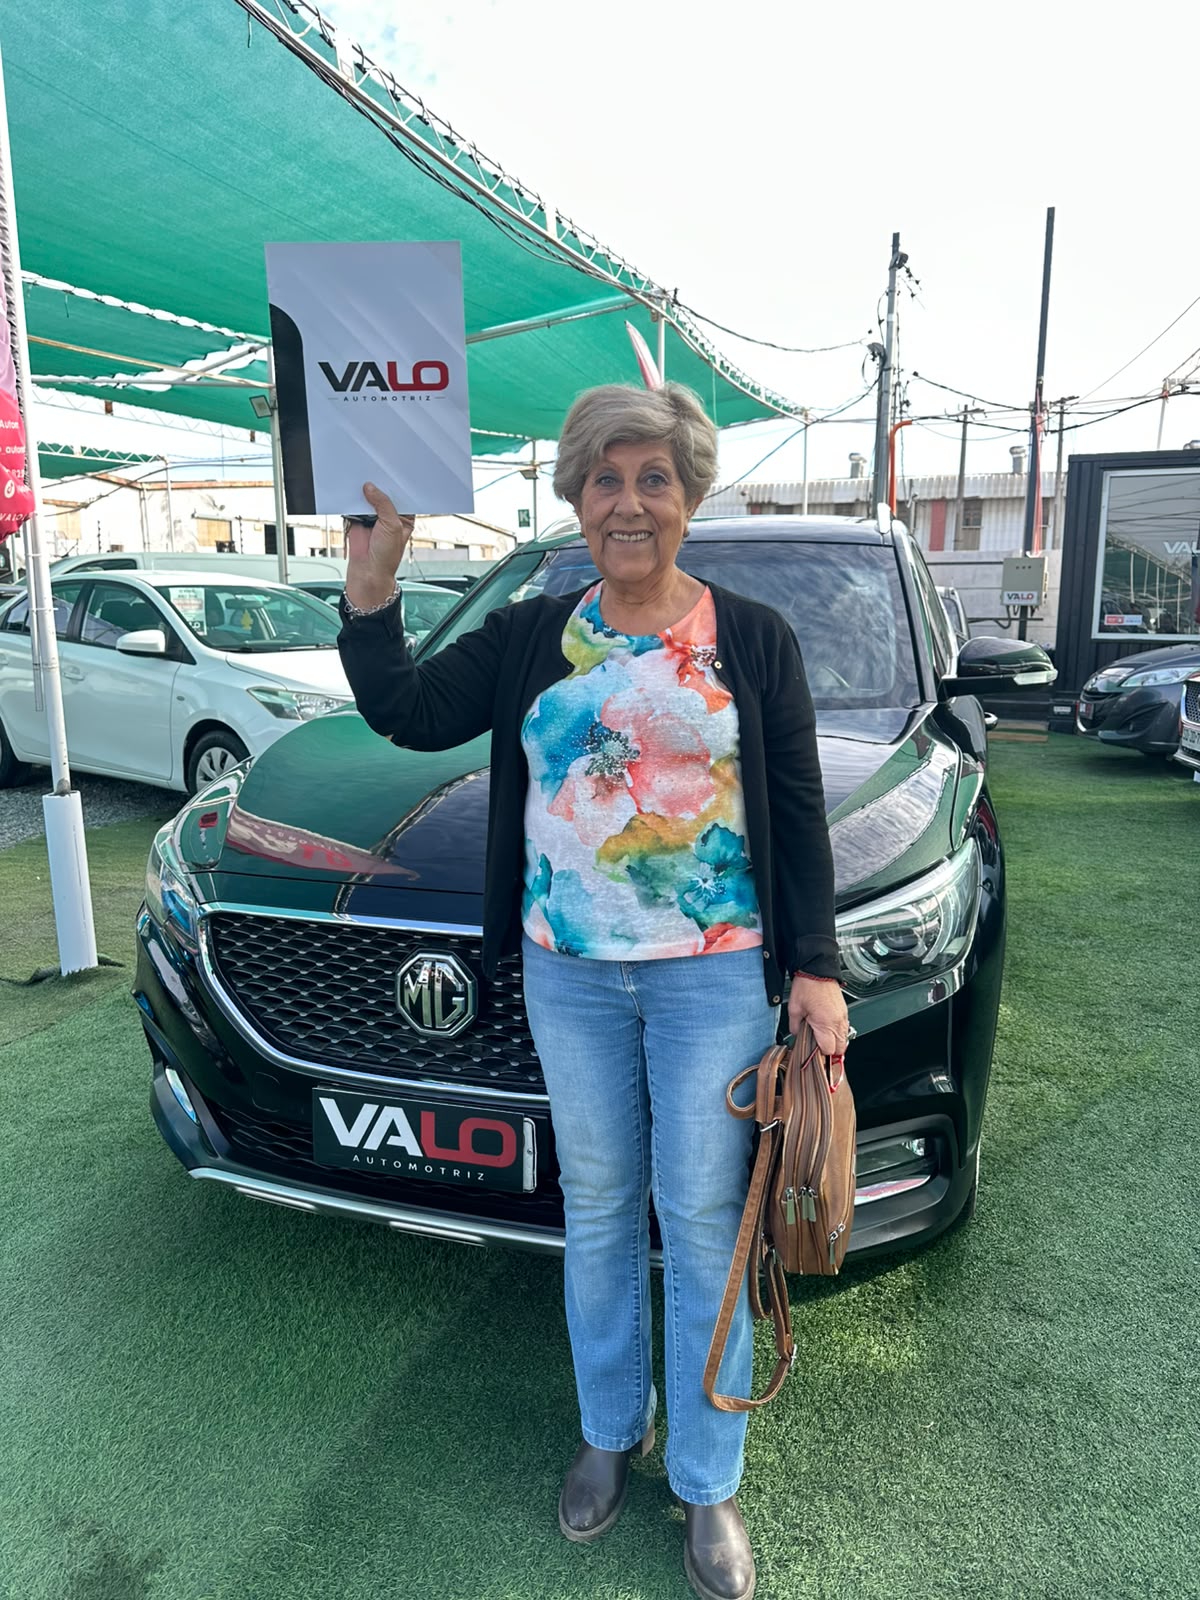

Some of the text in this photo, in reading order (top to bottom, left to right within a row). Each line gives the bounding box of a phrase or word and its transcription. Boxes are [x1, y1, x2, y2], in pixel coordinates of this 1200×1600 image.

[318, 361, 449, 392] VALO
[1007, 593, 1034, 601] VALO
[403, 961, 466, 1029] MG
[319, 1097, 517, 1168] VALO
[353, 1154, 486, 1181] AUTOMOTRIZ
